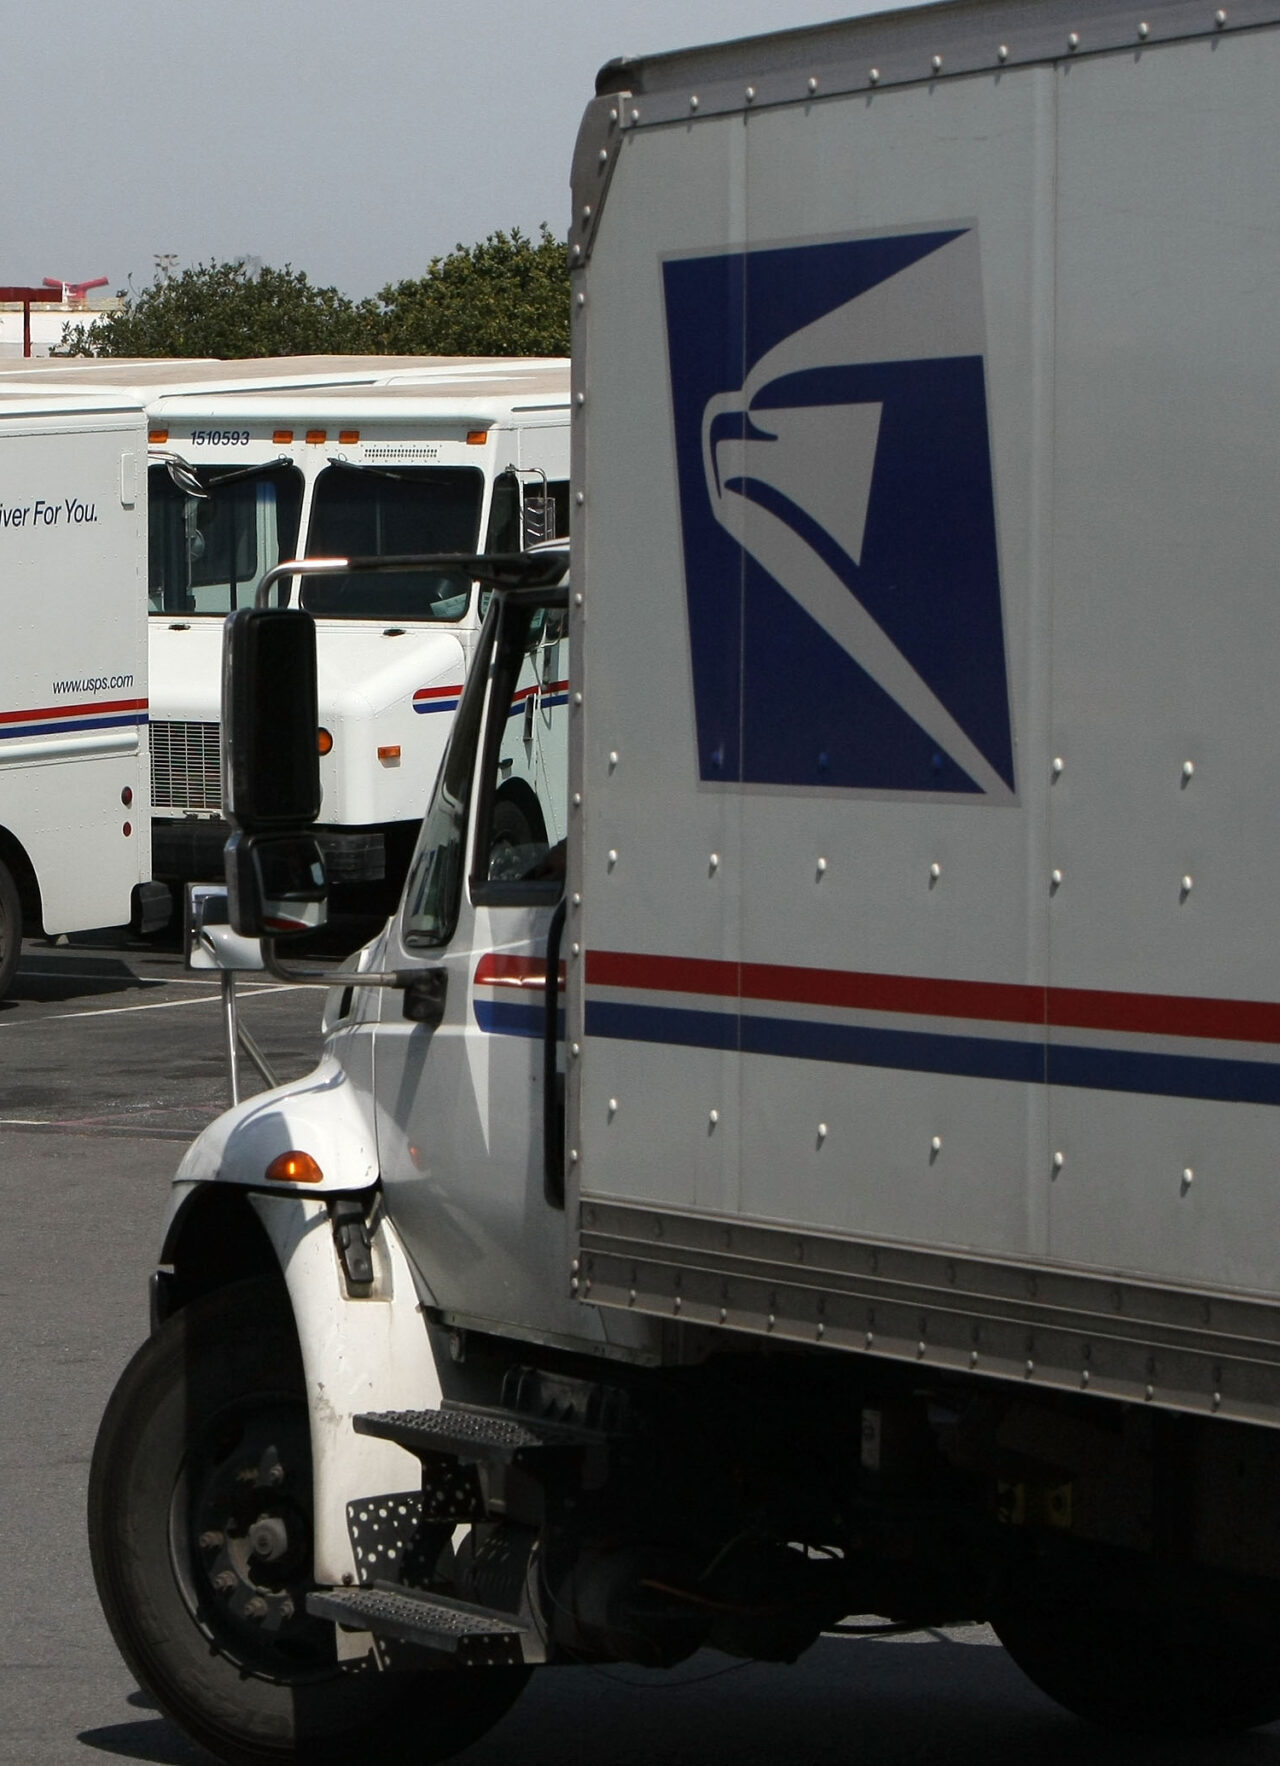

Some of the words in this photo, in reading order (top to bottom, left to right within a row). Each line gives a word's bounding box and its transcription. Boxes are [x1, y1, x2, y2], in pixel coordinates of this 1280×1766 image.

[190, 430, 250, 446] 1510593
[33, 500, 62, 525] For
[65, 498, 98, 523] You.
[52, 674, 134, 695] www.usps.com
